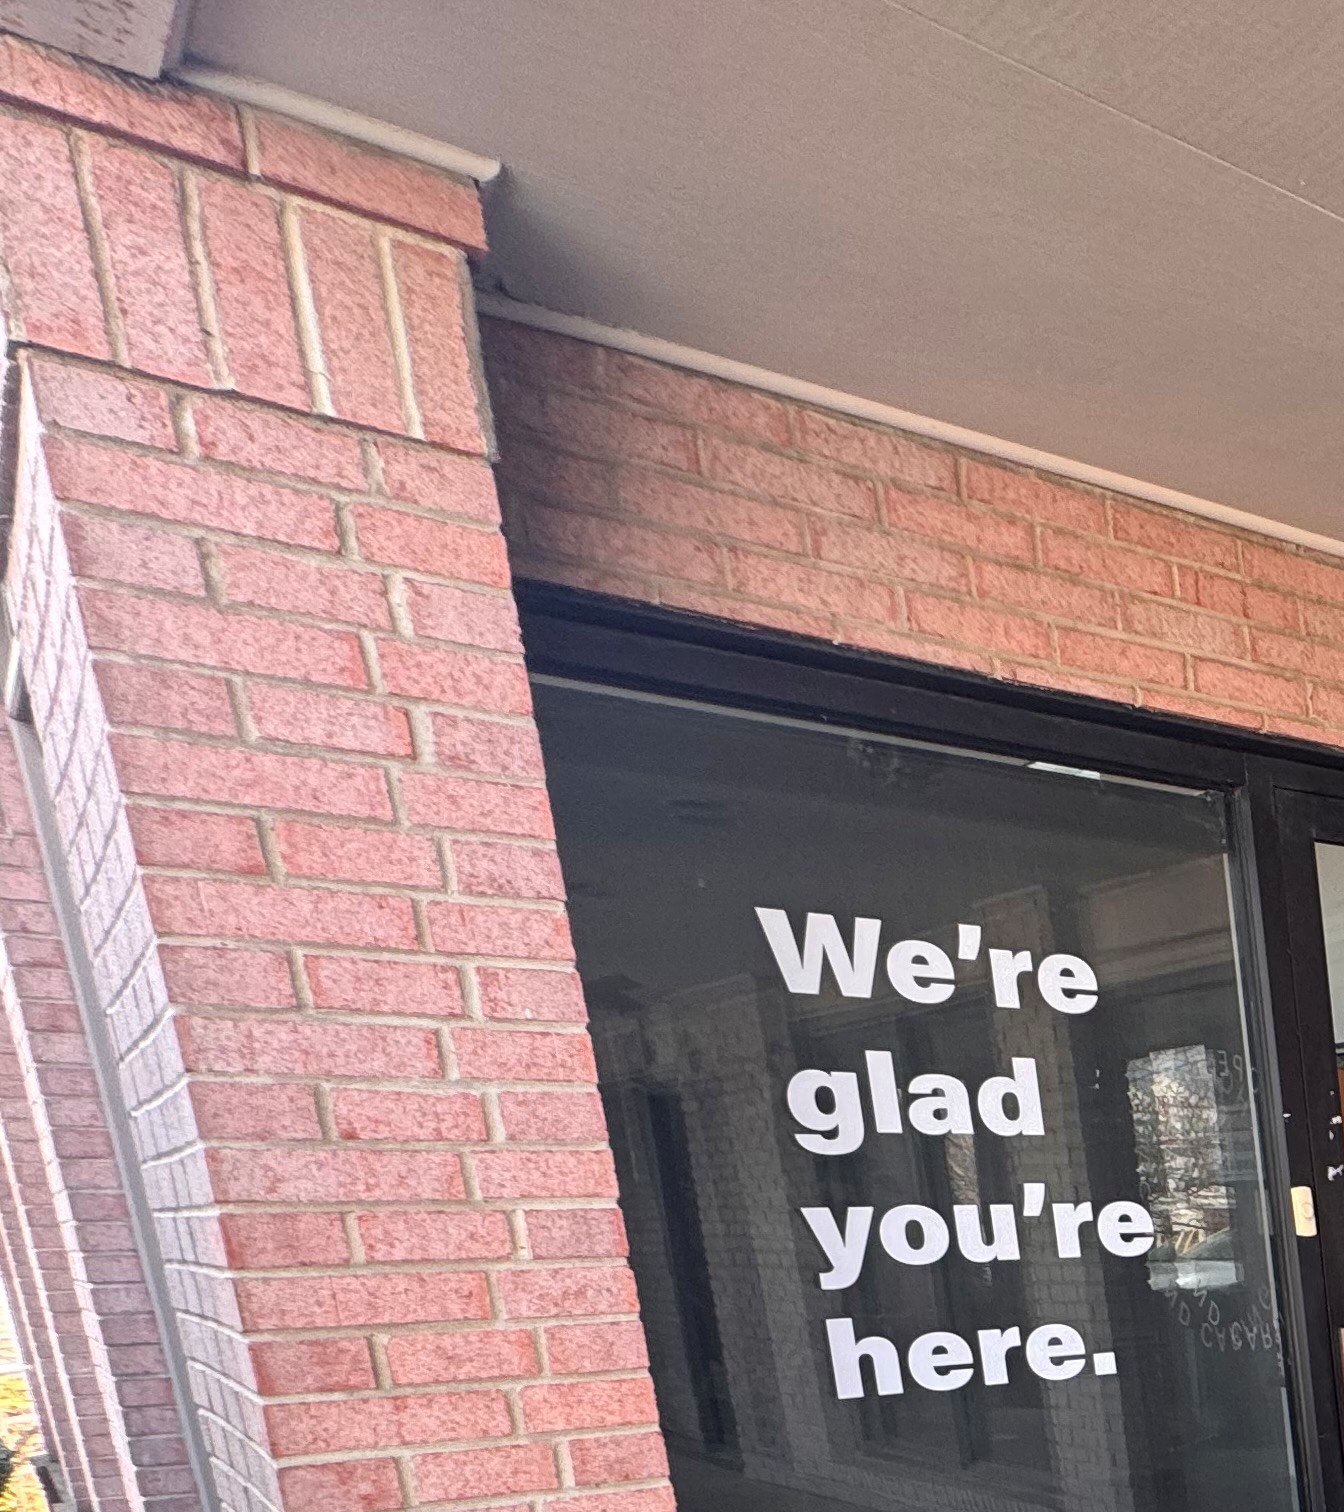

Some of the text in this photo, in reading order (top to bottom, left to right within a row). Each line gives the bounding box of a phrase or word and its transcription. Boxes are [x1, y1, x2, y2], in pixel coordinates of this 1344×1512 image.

[754, 907, 1098, 1014] We're
[787, 1050, 1045, 1155] glad
[800, 1182, 1154, 1290] you're
[825, 1317, 1117, 1399] here.
